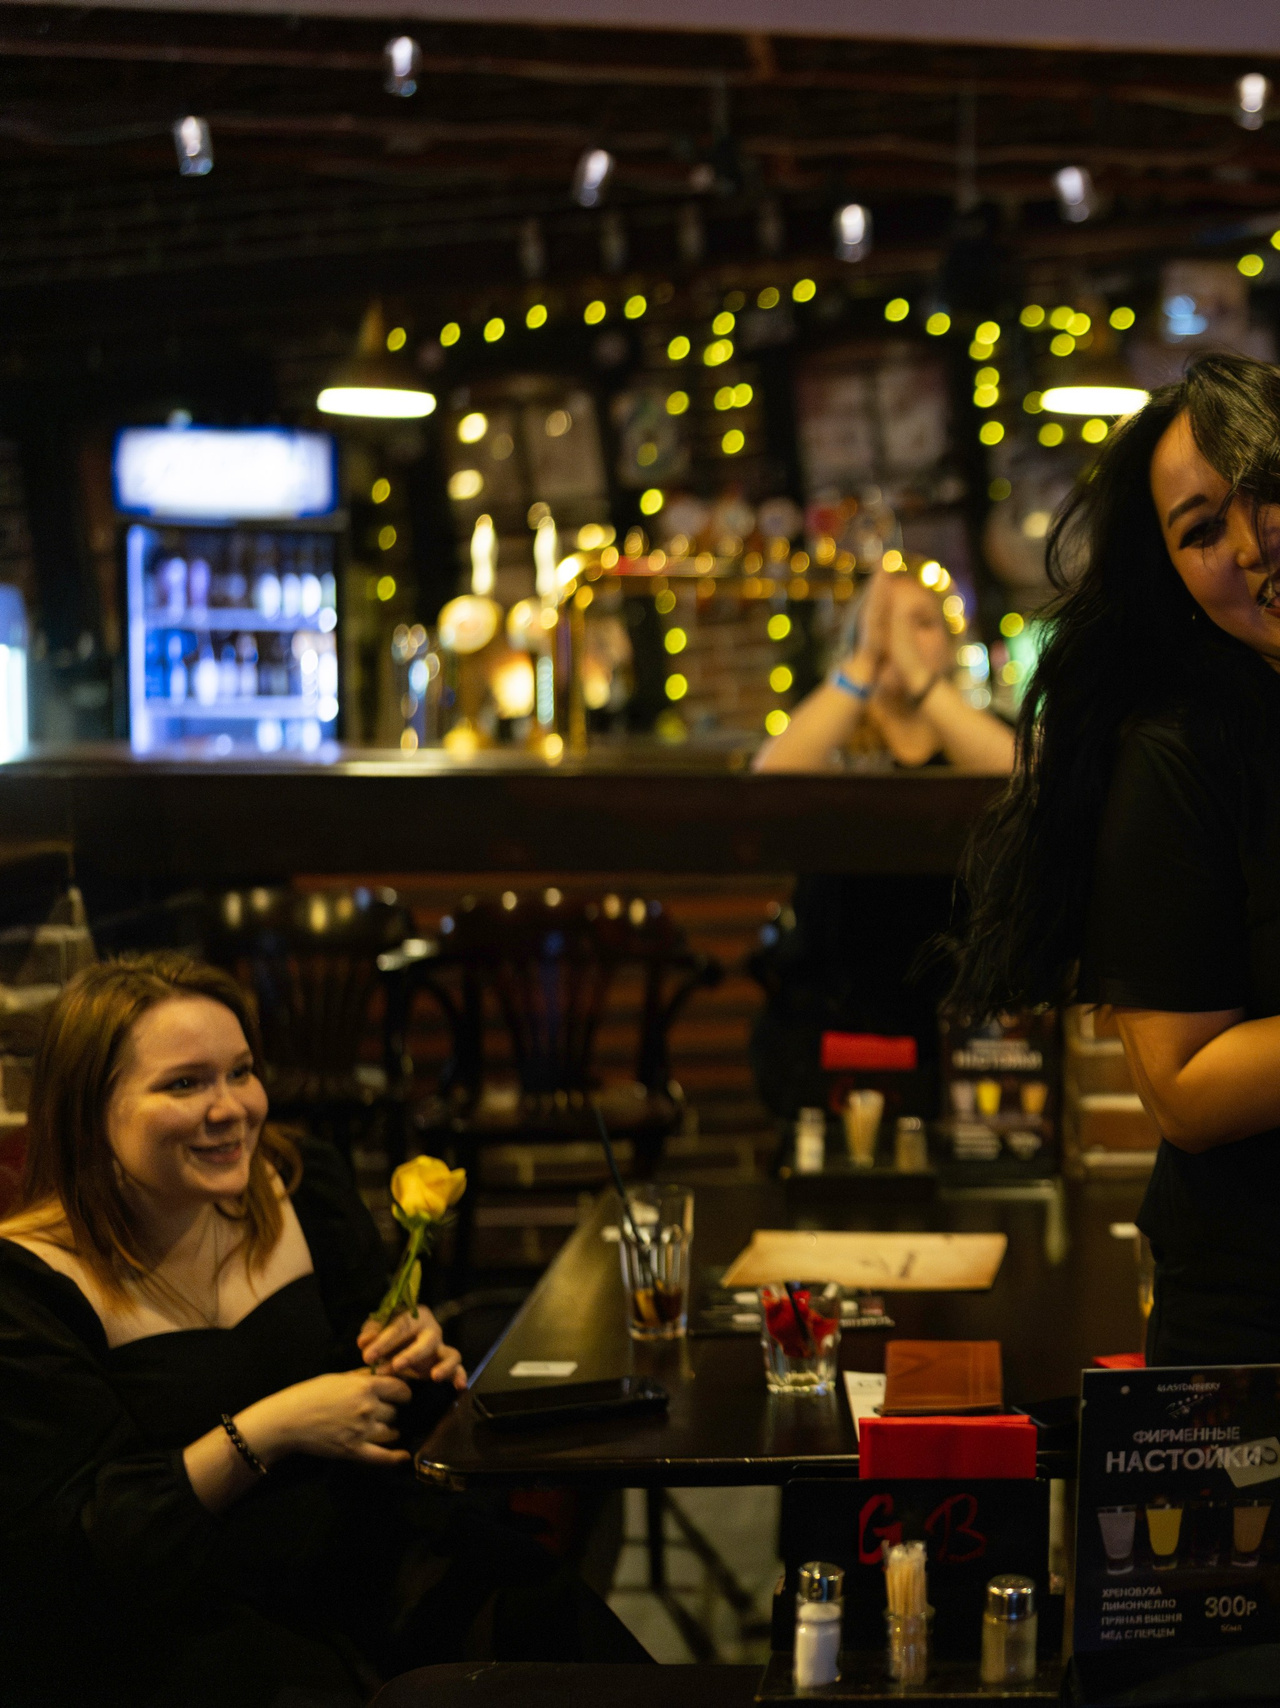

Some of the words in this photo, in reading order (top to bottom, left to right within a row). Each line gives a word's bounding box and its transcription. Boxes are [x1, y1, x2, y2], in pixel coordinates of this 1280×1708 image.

[1132, 1425, 1241, 1445] ФИРМЕННЫЕ
[1105, 1443, 1262, 1475] НАСТОЙКИ
[1101, 1585, 1163, 1599] ХРЕНОВУХА
[1101, 1598, 1177, 1612] ЛИМОНЧЕЛЛО
[1100, 1614, 1143, 1627] ПРЯНАЯ
[1144, 1612, 1183, 1625] ВИШНЯ
[1134, 1626, 1176, 1640] ПЕРЦЕМ
